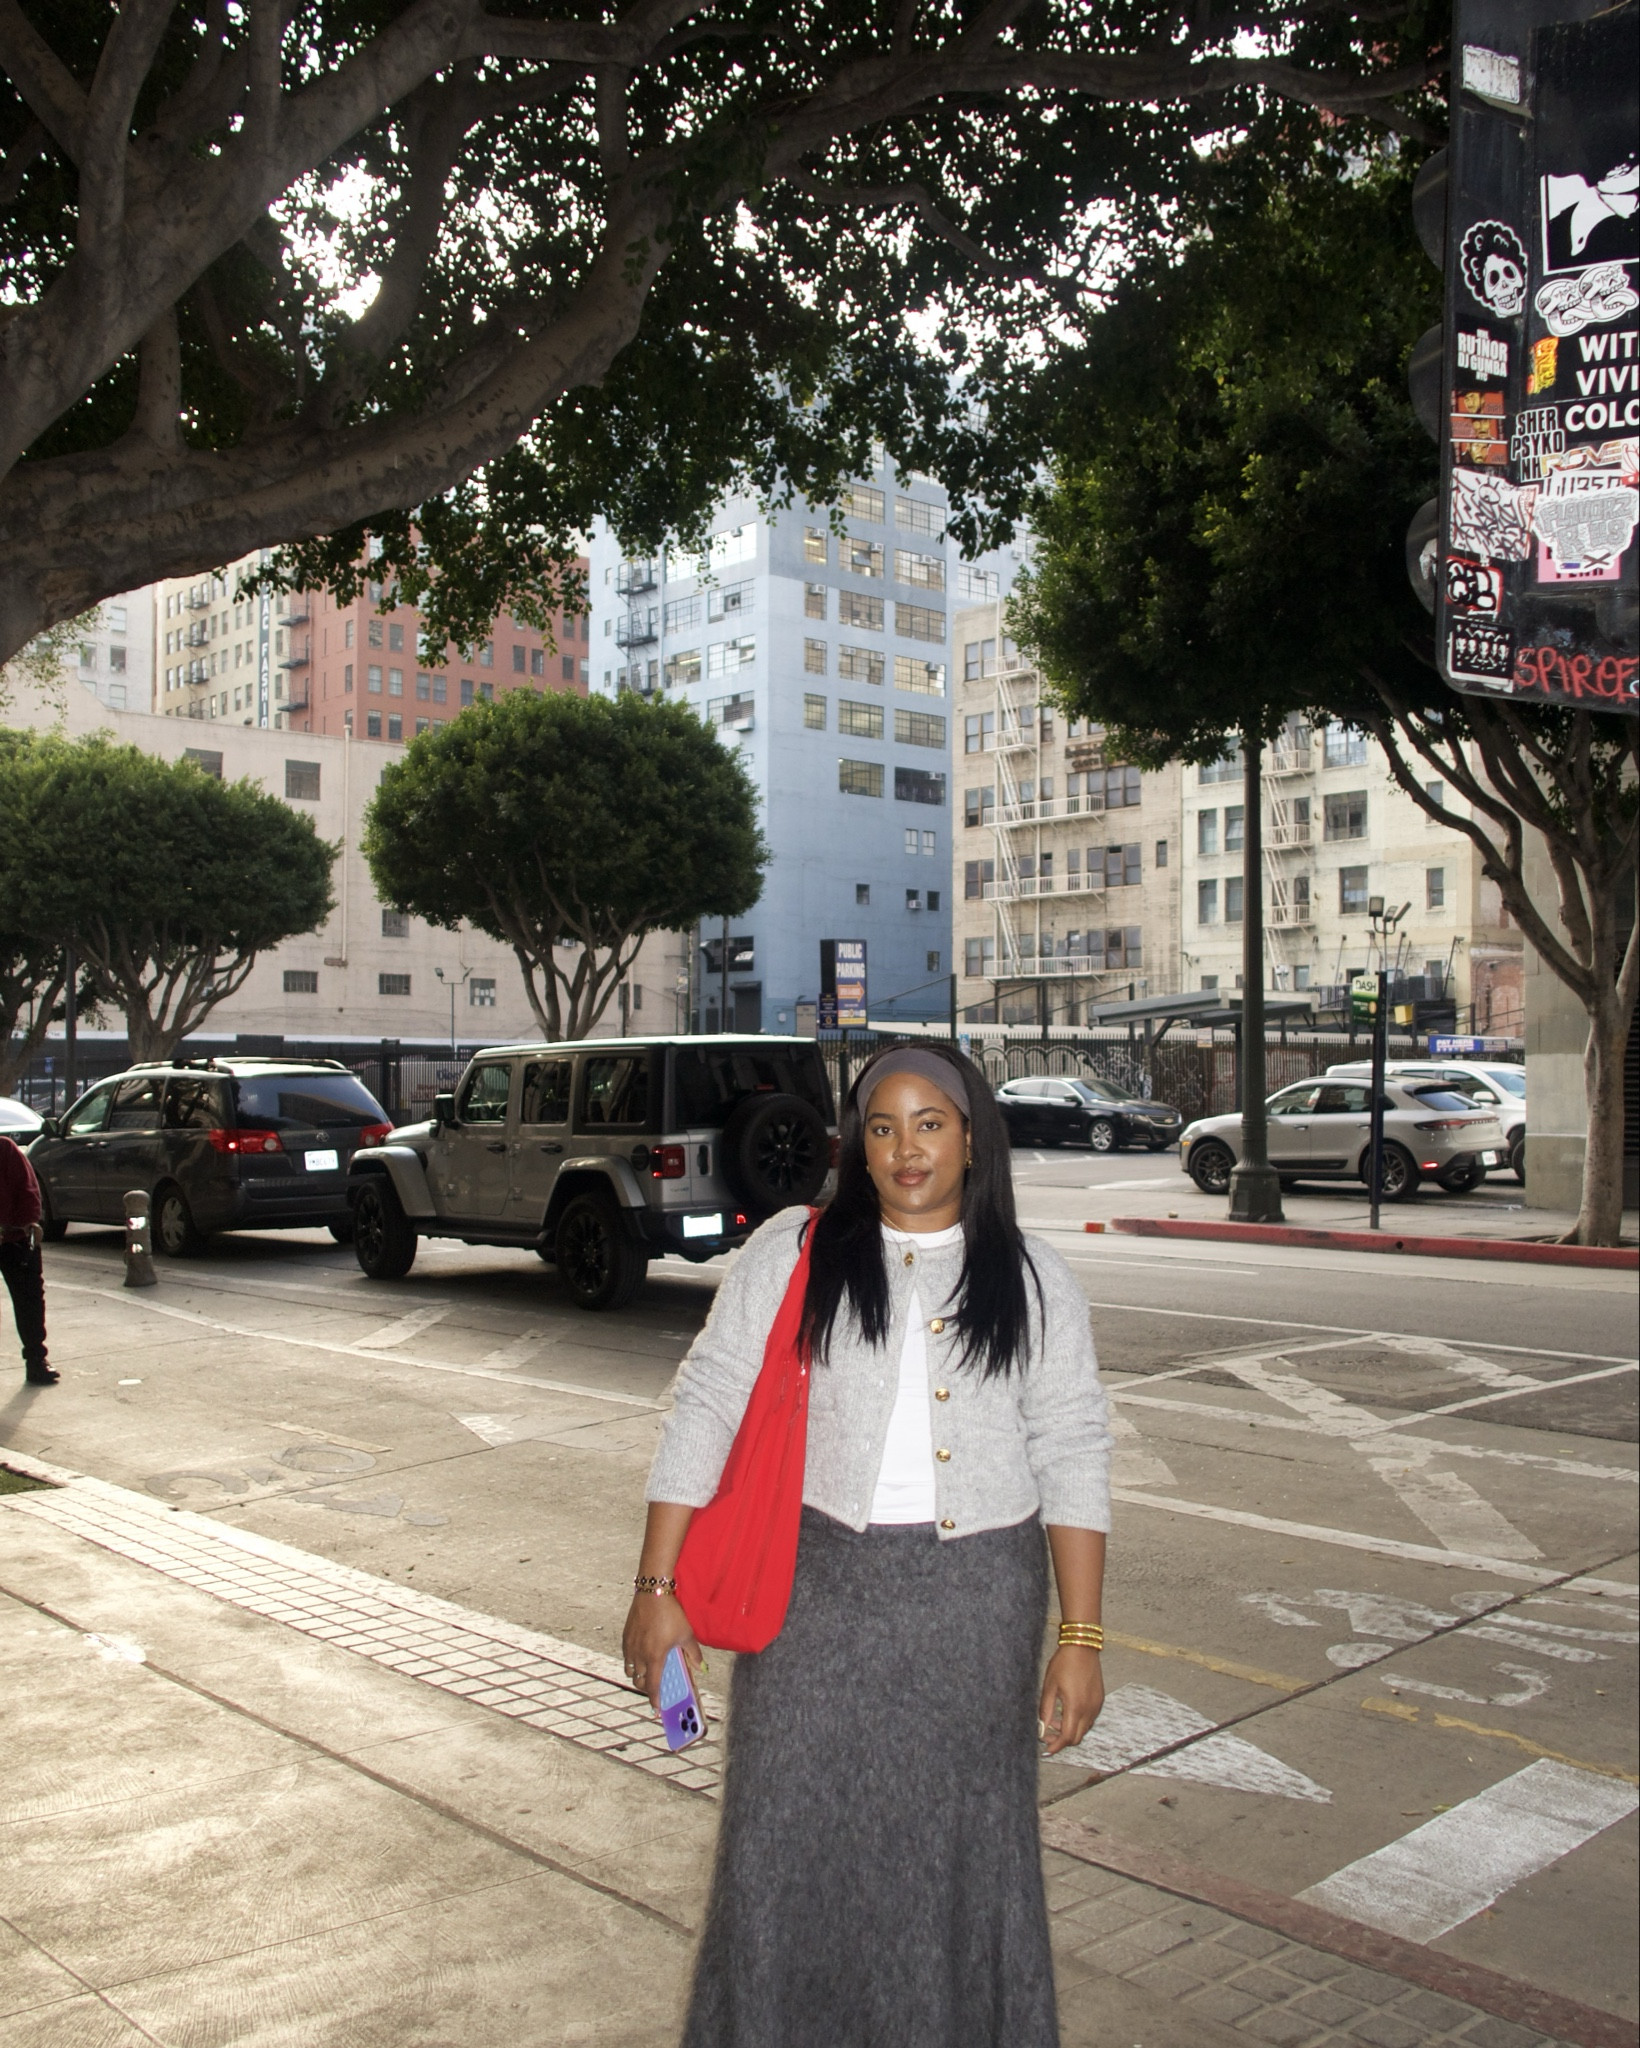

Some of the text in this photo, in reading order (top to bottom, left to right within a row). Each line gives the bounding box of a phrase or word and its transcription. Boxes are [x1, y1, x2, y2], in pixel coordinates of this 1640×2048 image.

[1578, 331, 1640, 363] WIT
[1457, 352, 1508, 377] DJ GUMBA
[1475, 371, 1488, 382] NYC
[1517, 408, 1557, 436] SHER
[1512, 431, 1564, 459] PSYKO
[838, 942, 863, 959] PUBLIC
[836, 962, 865, 978] PARKING
[1355, 980, 1377, 993] DASH
